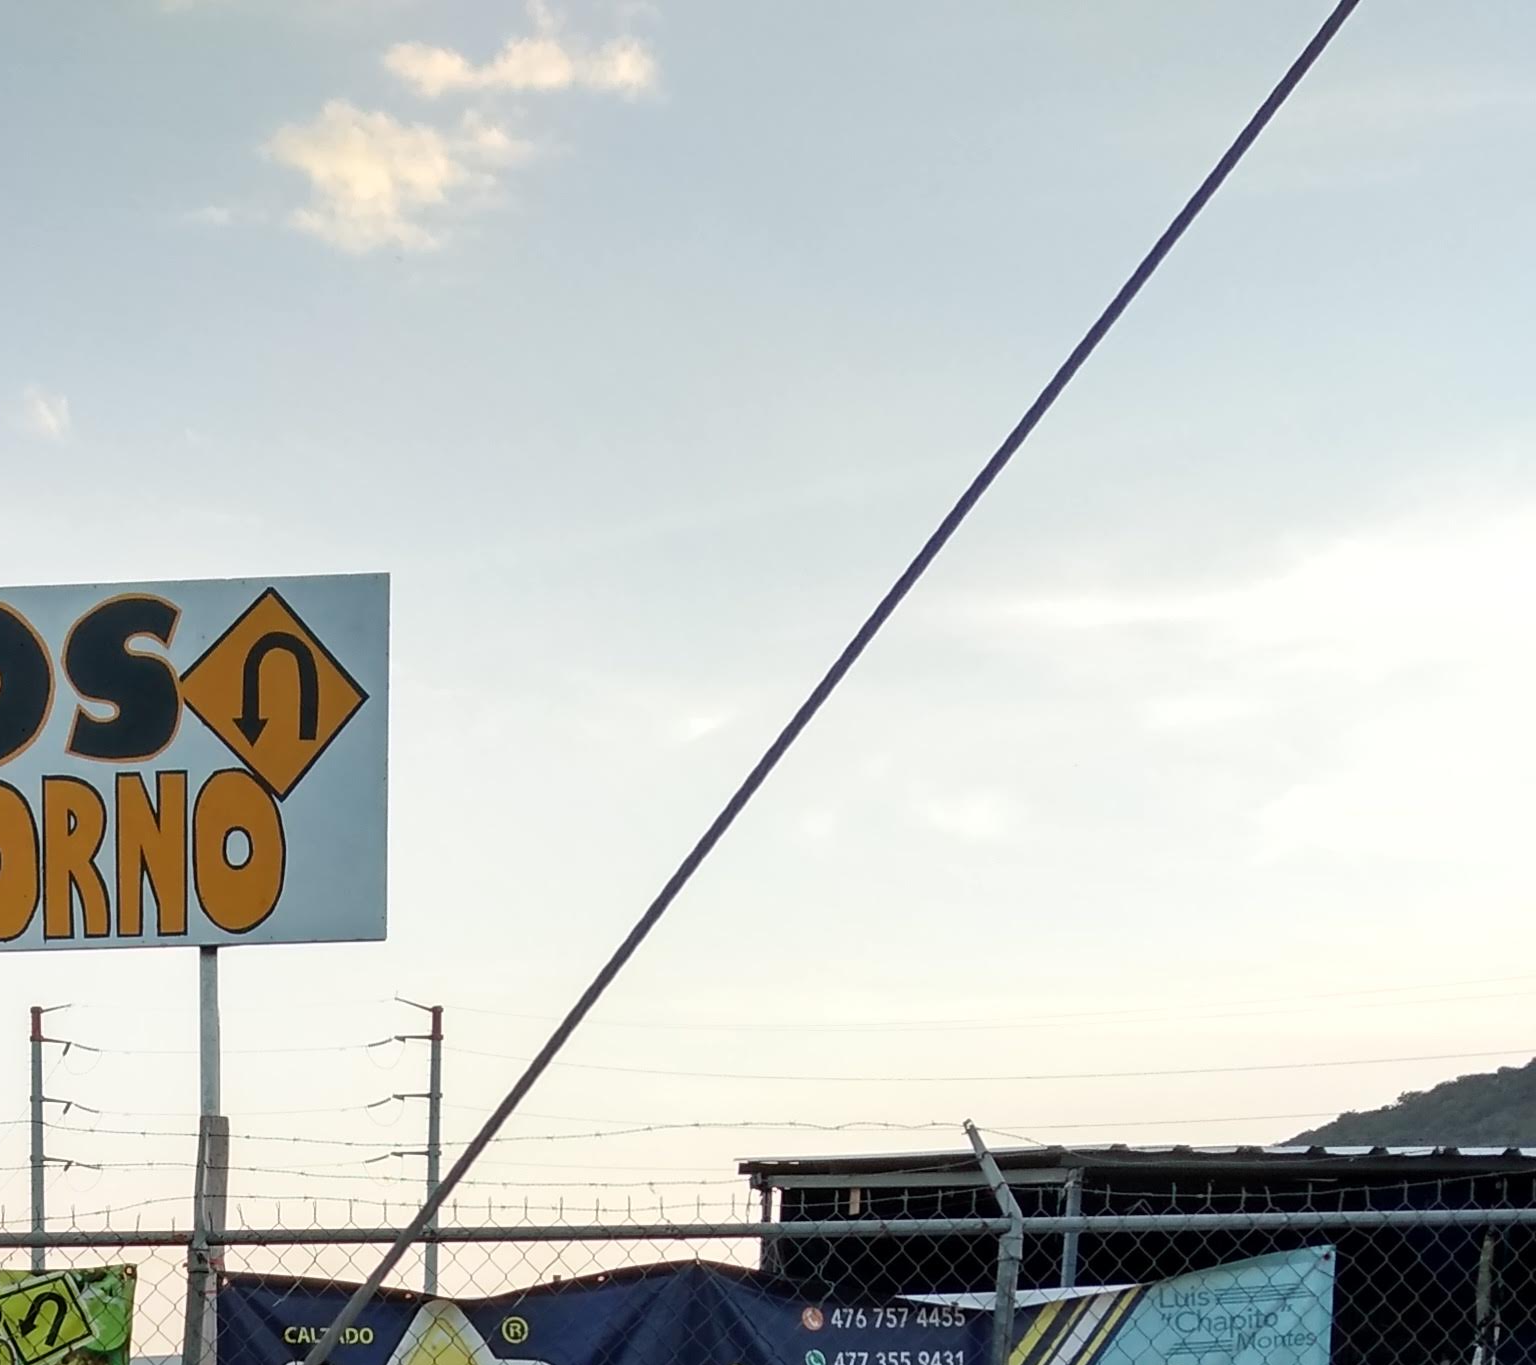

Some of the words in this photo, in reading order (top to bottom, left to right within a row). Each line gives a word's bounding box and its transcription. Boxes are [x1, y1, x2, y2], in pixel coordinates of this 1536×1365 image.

[1159, 1286, 1210, 1308] Luis
[831, 1308, 867, 1329] 476
[873, 1307, 909, 1328] 757
[917, 1306, 966, 1328] 4455
[1236, 1331, 1315, 1350] Montes
